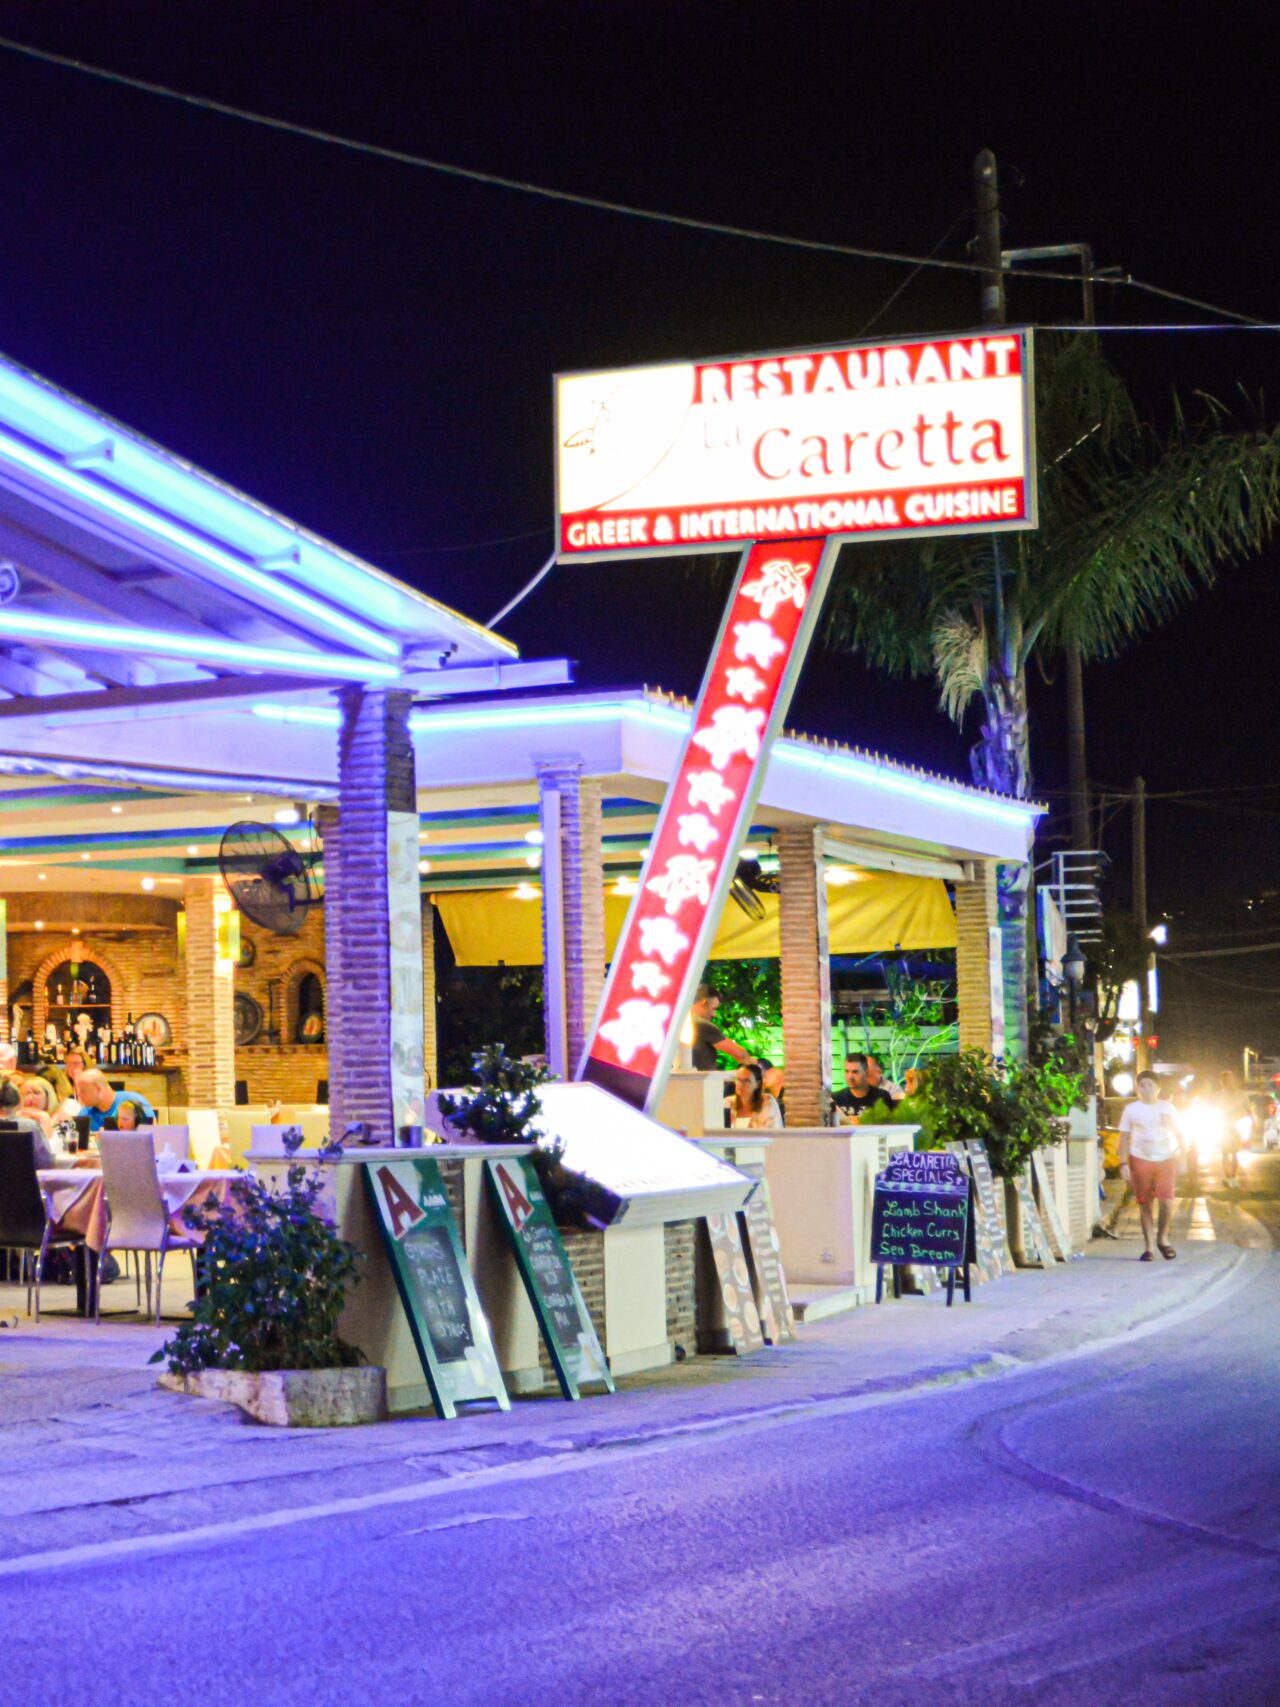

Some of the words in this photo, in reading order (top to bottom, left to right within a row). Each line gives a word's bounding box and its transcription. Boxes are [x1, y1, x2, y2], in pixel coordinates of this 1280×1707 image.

[701, 340, 1016, 402] RESTAURANT
[752, 410, 1011, 481] Caretta
[567, 516, 649, 547] GREEK
[654, 514, 673, 541] &
[681, 497, 900, 540] INTERNATIONAL
[904, 487, 1018, 523] CUISINE
[883, 1201, 920, 1217] Lamb
[923, 1200, 968, 1219] Shank
[880, 1242, 905, 1256] Sea
[909, 1243, 956, 1260] Bream
[882, 1223, 923, 1238] Chicken
[927, 1222, 960, 1241] Curry
